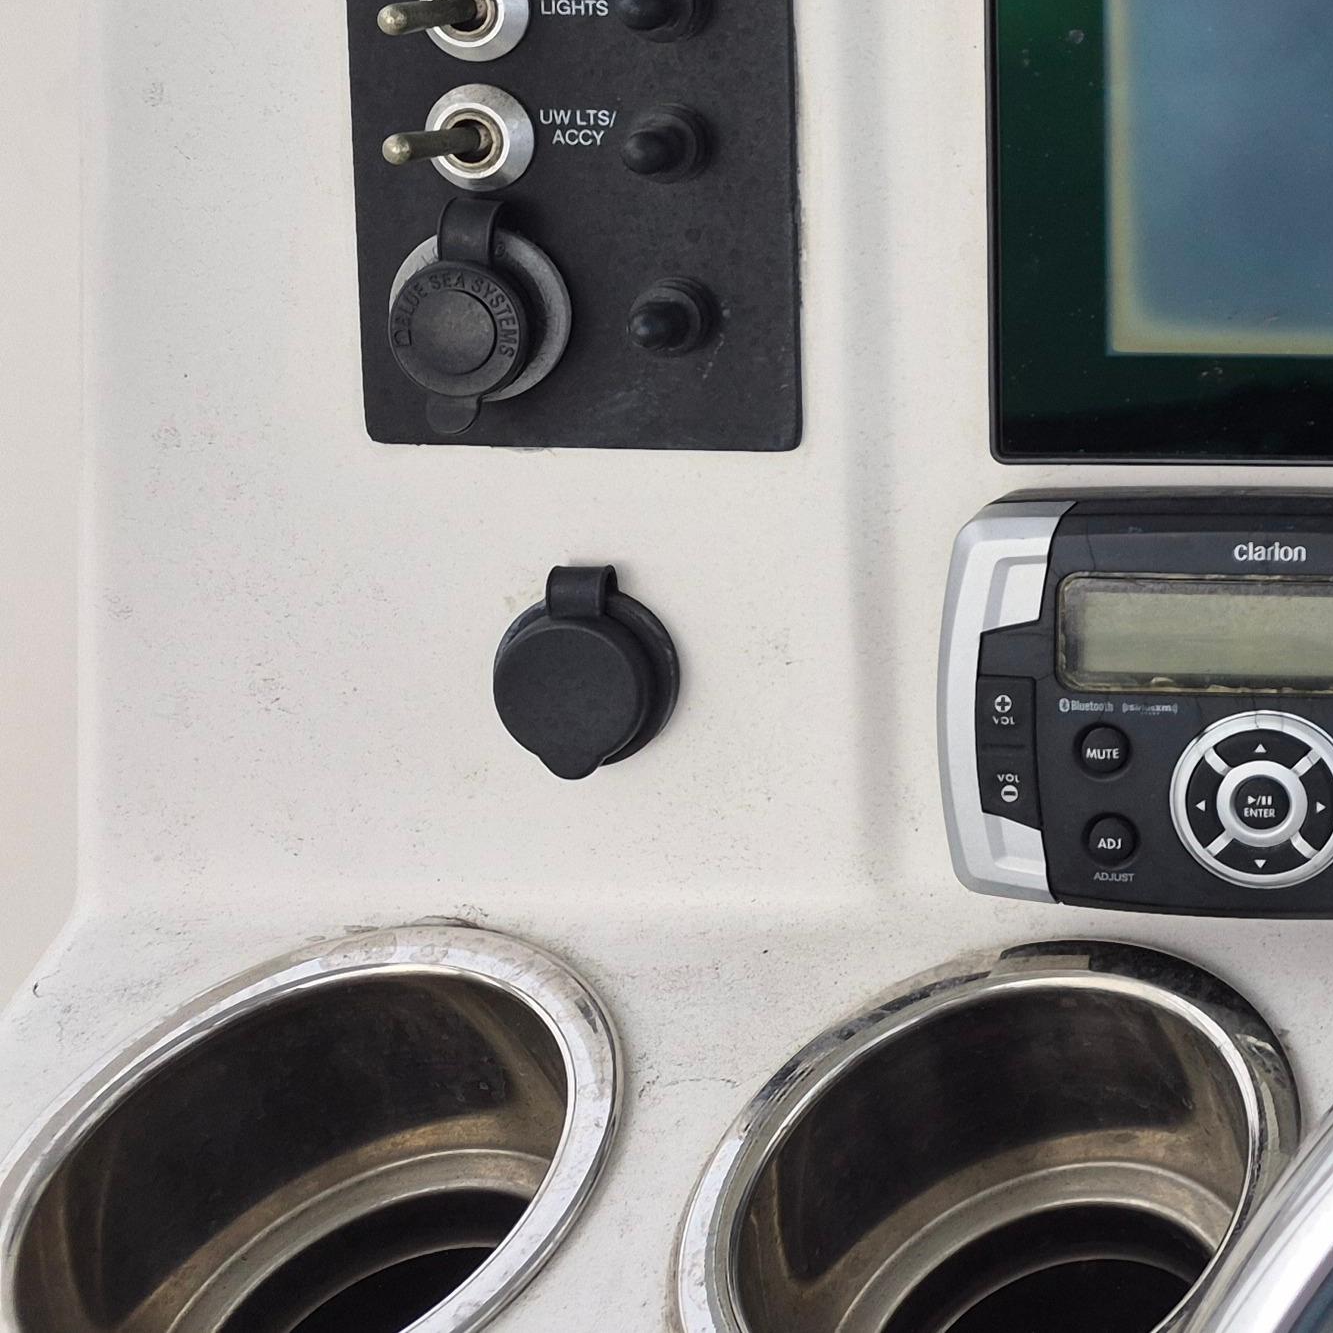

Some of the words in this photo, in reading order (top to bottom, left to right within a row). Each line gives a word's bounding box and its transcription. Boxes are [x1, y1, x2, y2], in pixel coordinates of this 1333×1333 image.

[541, 0, 609, 17] LIGHTS
[540, 109, 572, 126] UW
[576, 110, 617, 127] LTS/
[552, 129, 605, 146] ACCY
[429, 272, 465, 291] SEA
[471, 278, 518, 358] SYSTEMS
[1233, 541, 1307, 562] clarion
[993, 716, 1015, 725] VOL
[1086, 747, 1120, 760] MUTE
[997, 773, 1020, 783] VOL
[1243, 807, 1276, 818] ENTER
[1097, 837, 1122, 850] ADJ
[1093, 872, 1136, 882] ADJUST
